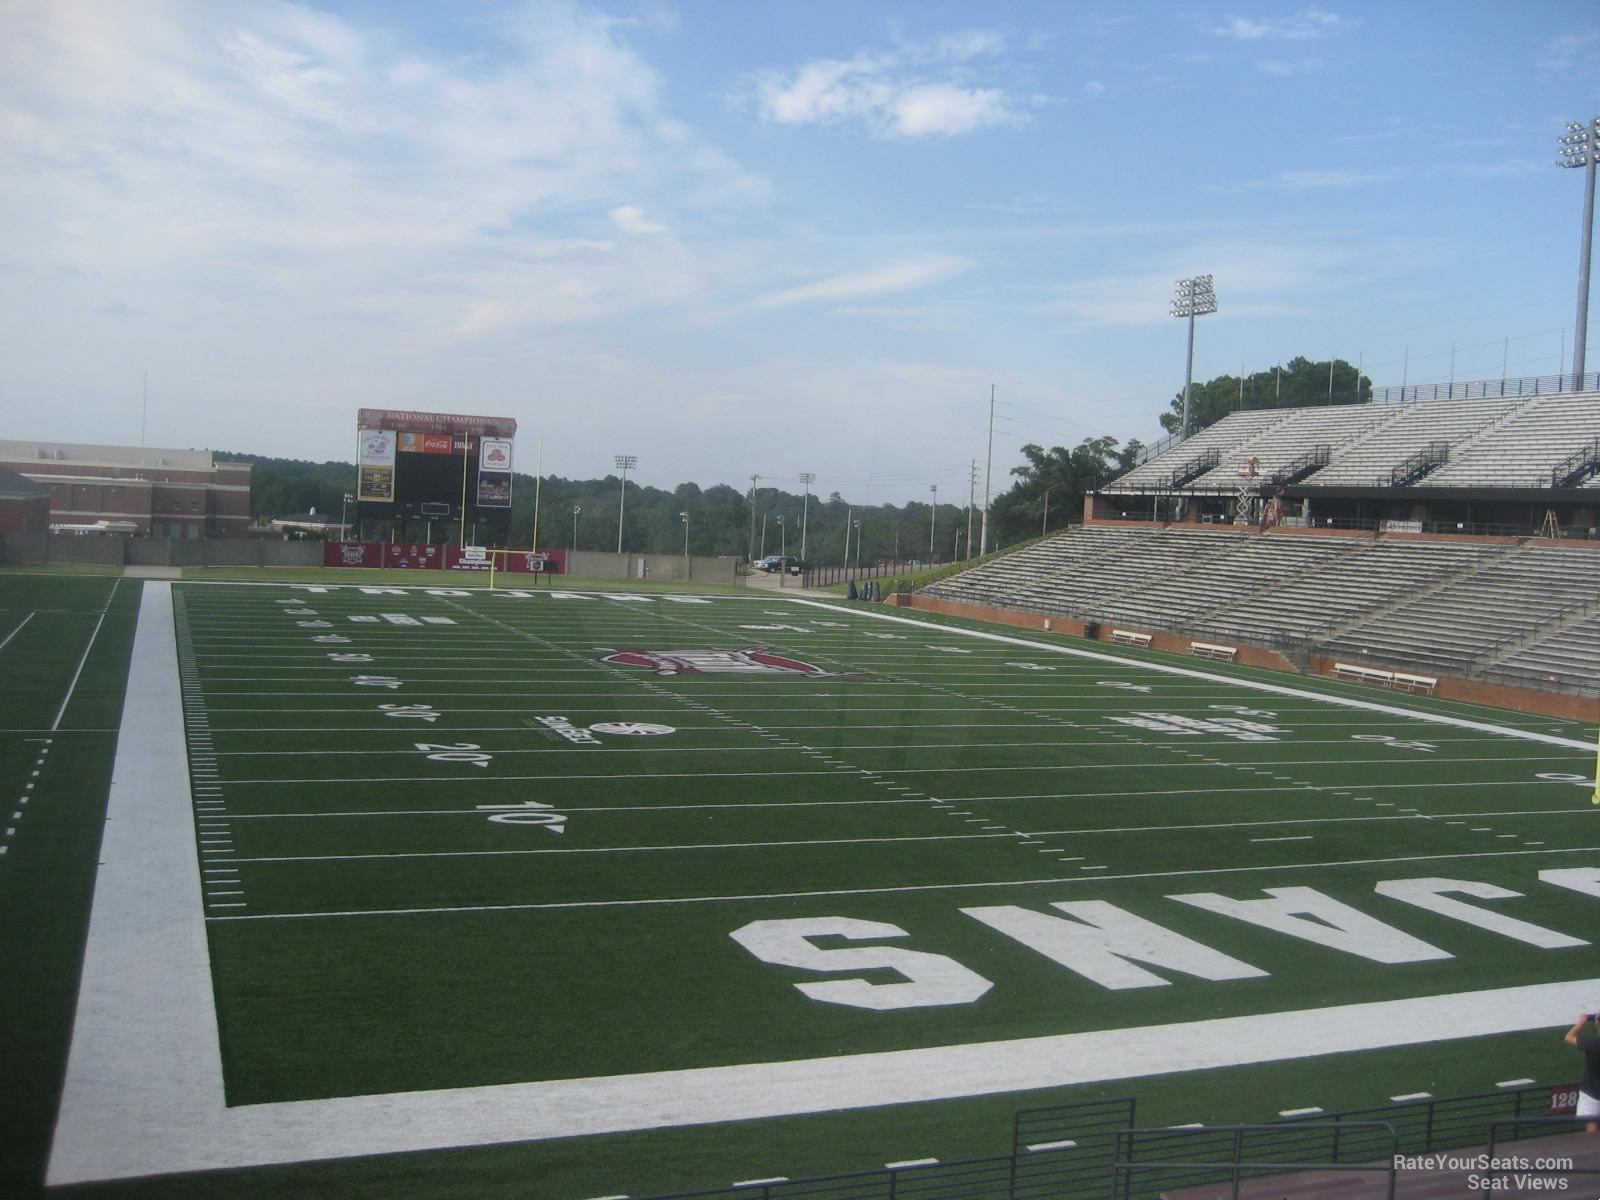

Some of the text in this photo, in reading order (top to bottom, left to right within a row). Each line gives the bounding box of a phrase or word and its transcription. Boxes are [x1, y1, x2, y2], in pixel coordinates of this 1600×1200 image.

[387, 412, 493, 425] NATIONAL CHAMPIONS
[377, 703, 441, 718] 30
[414, 742, 493, 761] 20
[476, 801, 568, 824] 10
[1551, 1091, 1577, 1108] 128
